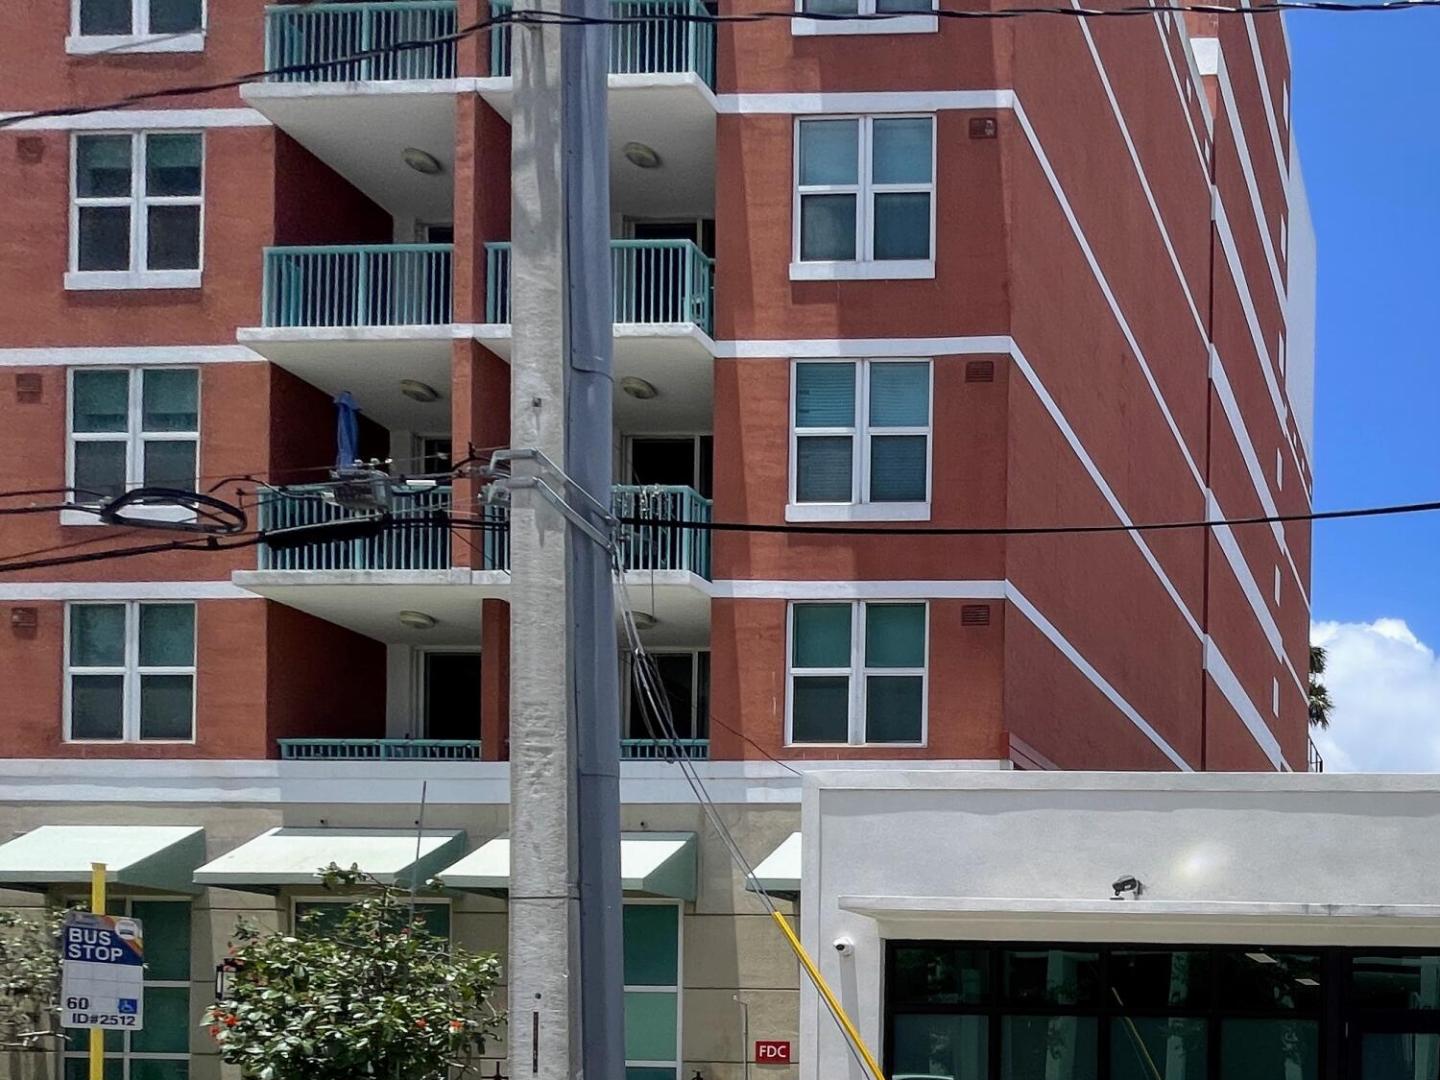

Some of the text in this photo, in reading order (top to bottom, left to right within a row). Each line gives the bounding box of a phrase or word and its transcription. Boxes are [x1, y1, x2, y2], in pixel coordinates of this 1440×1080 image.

[69, 928, 111, 946] BUS
[68, 944, 123, 961] STOP
[67, 997, 89, 1010] 60
[72, 1013, 136, 1026] ID#2512
[759, 1045, 787, 1058] FDC
